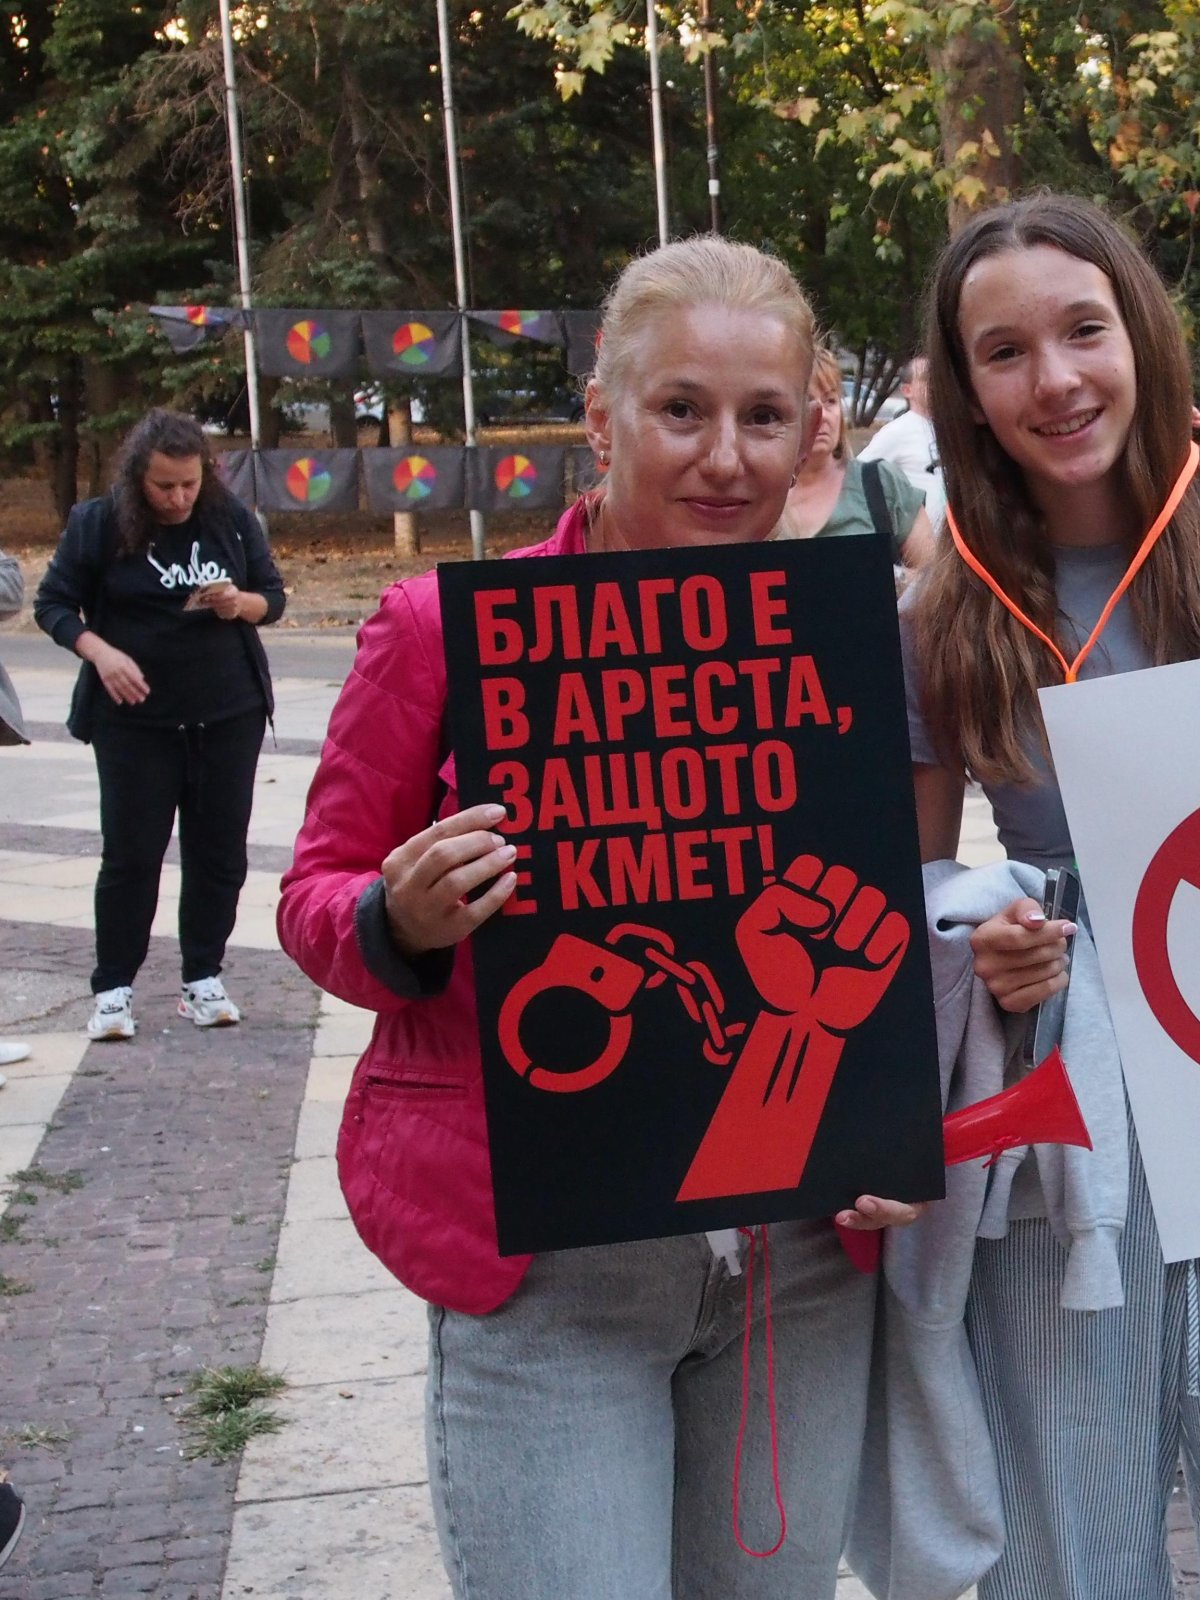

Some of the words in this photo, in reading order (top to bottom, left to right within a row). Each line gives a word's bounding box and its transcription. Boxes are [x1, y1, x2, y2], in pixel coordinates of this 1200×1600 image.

[473, 574, 728, 666] БЛАГО
[749, 570, 792, 647] Е
[481, 677, 530, 750] В
[552, 655, 854, 746] АРЕСТА,
[488, 739, 798, 834] ЗАЩОТО
[556, 824, 777, 911] КМЕТ!
